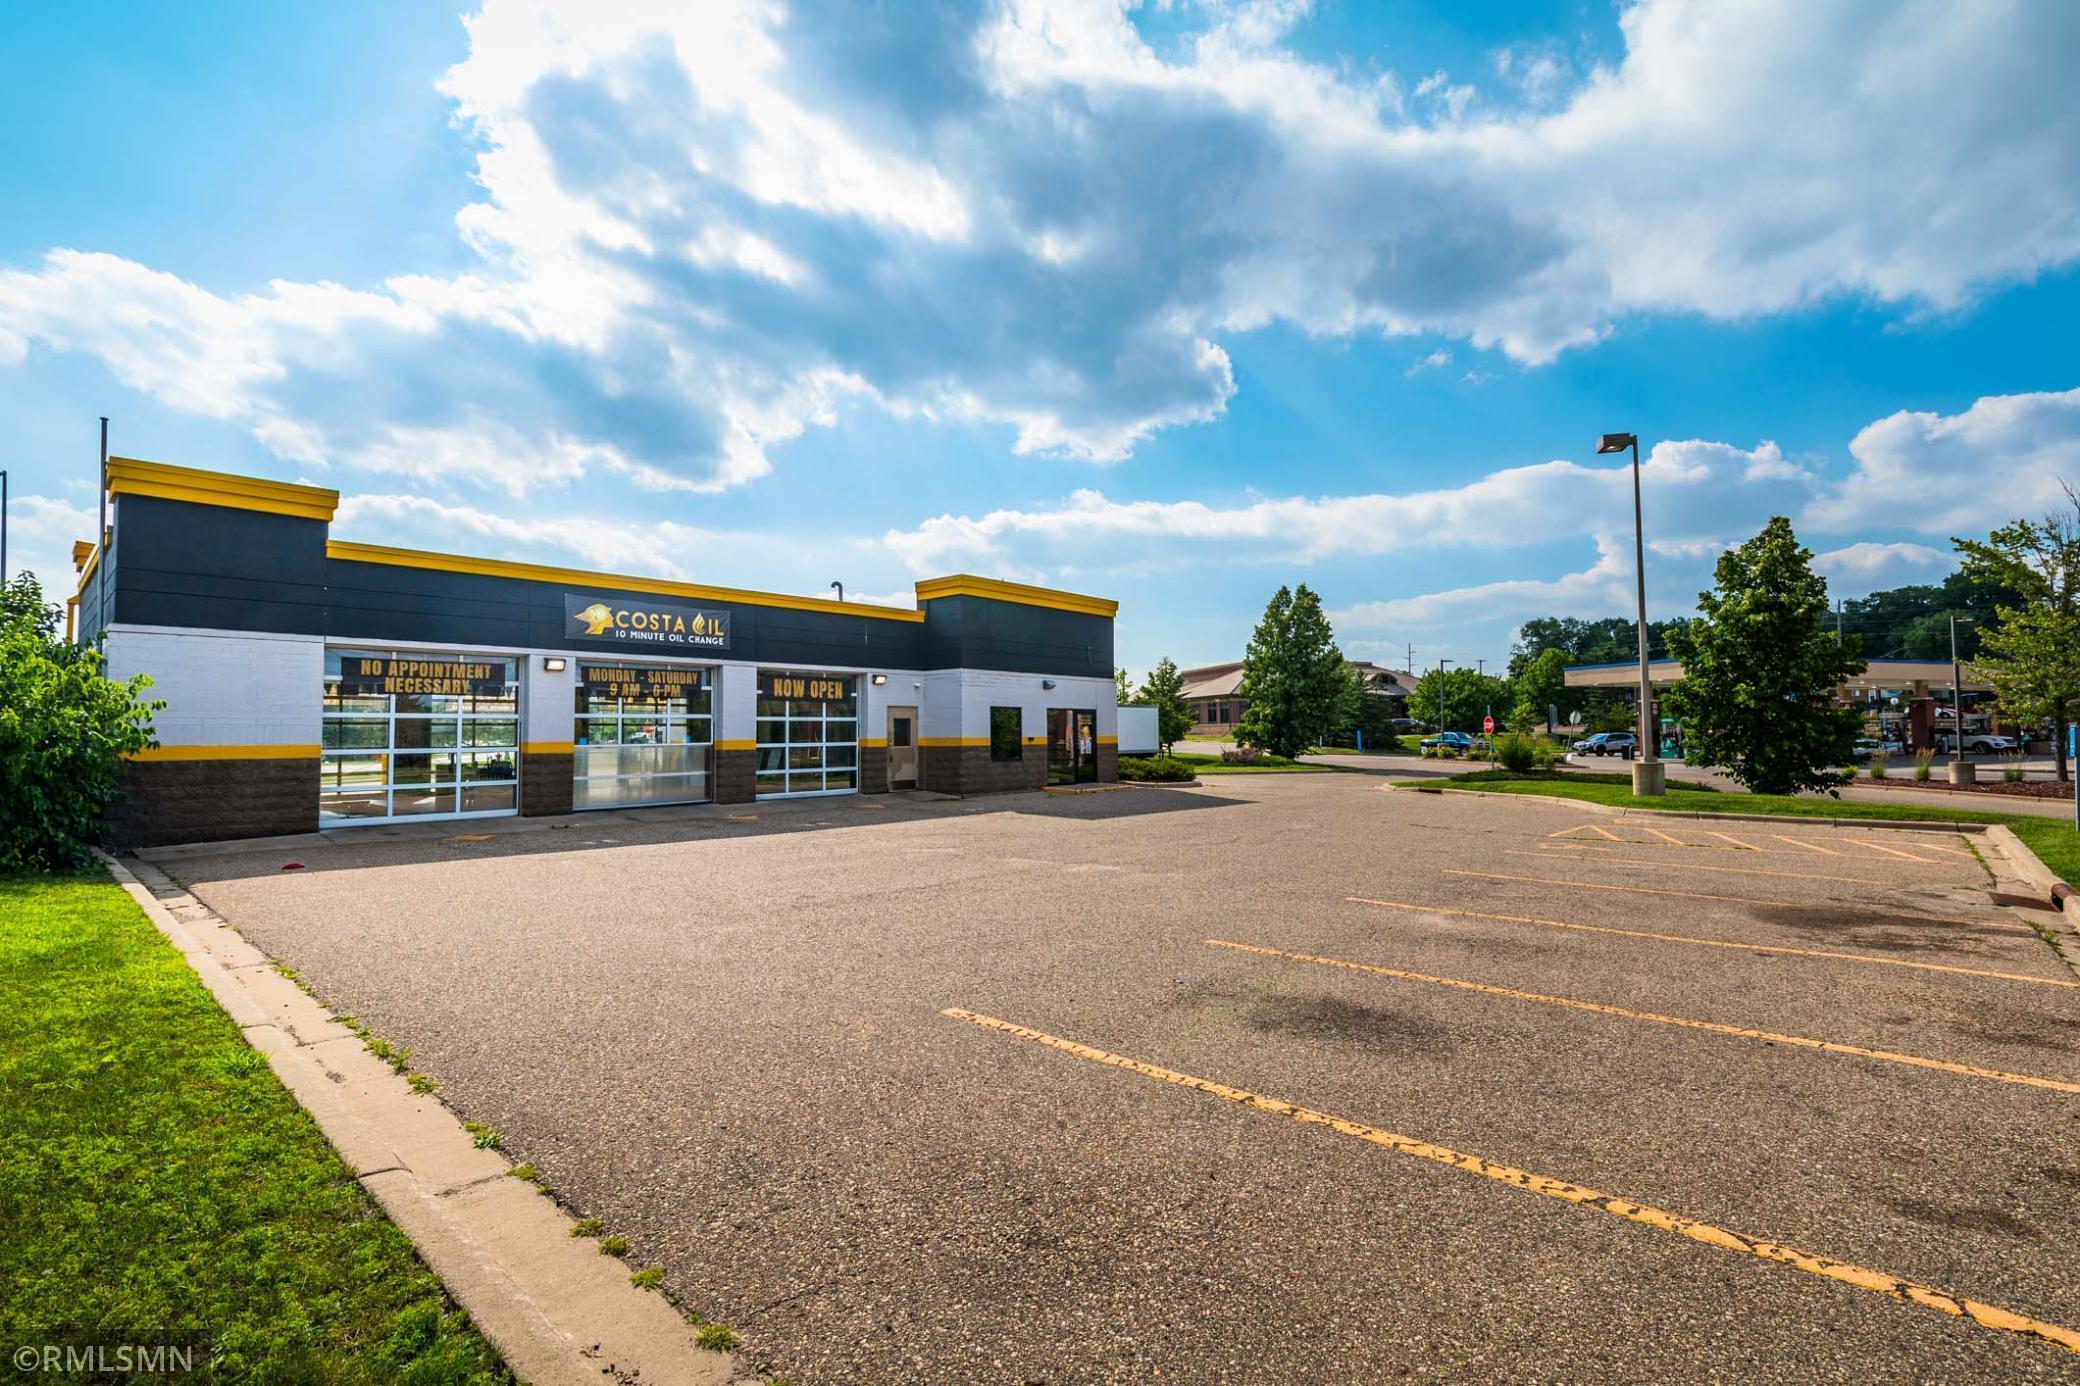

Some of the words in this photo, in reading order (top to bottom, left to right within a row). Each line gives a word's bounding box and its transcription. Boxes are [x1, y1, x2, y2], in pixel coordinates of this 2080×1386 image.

[616, 610, 686, 633] COSTA
[615, 630, 626, 638] 10
[630, 631, 665, 641] MINUTE
[669, 634, 685, 643] OIL
[688, 636, 724, 645] CHANGE
[361, 660, 382, 675] NO
[388, 661, 492, 679] APPOINTMENT
[589, 668, 636, 683] MONDAY
[647, 671, 698, 685] SATURDAY
[385, 678, 470, 694] NECESSARY
[609, 683, 618, 697] 9
[622, 684, 640, 697] AM
[663, 685, 681, 698] PM
[774, 678, 805, 697] NOW
[810, 681, 843, 699] OPEN
